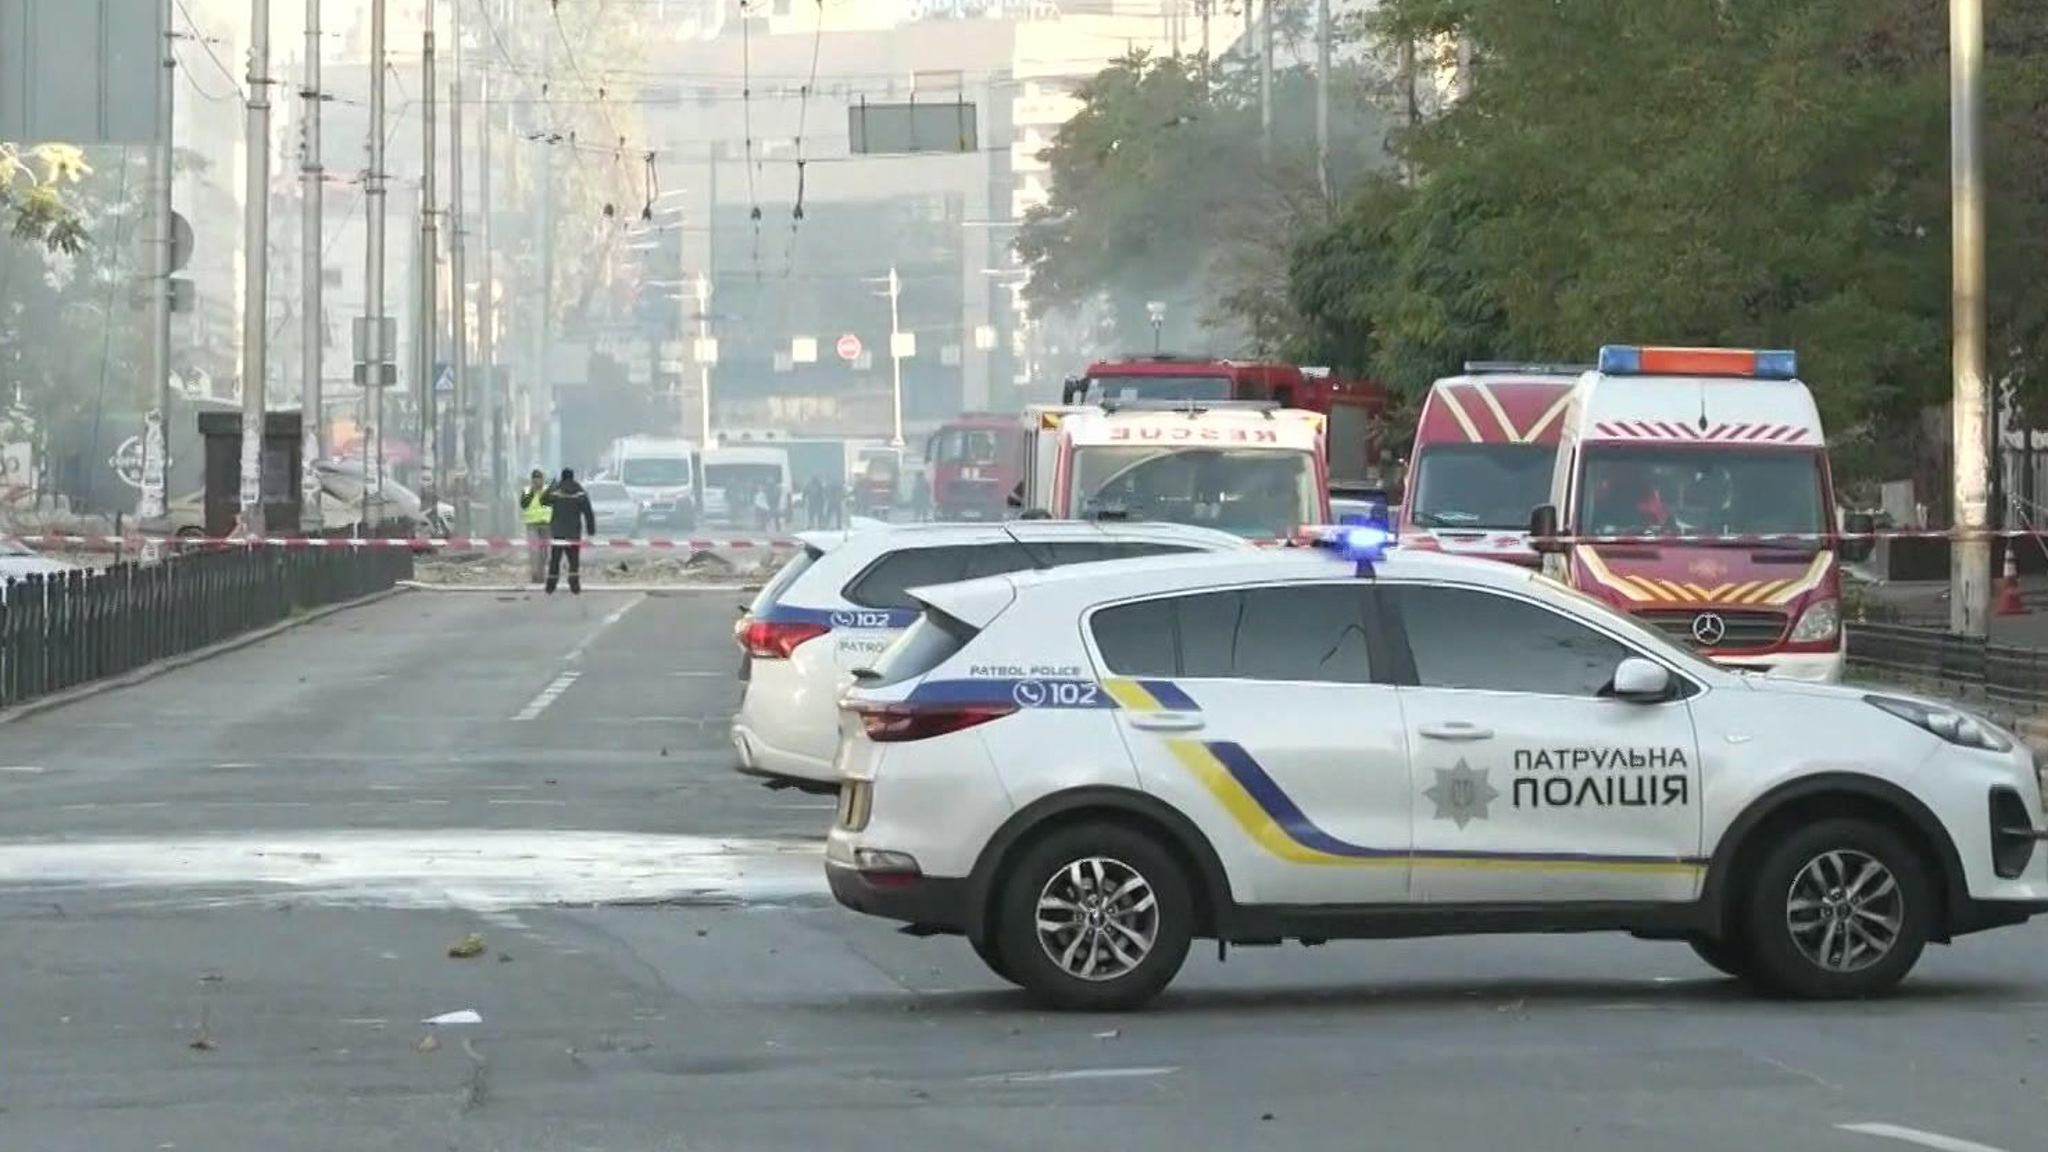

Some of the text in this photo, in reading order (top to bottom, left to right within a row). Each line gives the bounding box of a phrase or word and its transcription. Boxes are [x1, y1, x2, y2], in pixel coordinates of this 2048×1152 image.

[856, 612, 890, 627] 102
[839, 641, 885, 655] PATRO
[969, 665, 1081, 676] PATROL POLICE
[1049, 682, 1098, 705] 102
[1514, 747, 1688, 771] ПАТРУЛЬНА
[1512, 774, 1688, 809] ПОЛІЦІЯ
